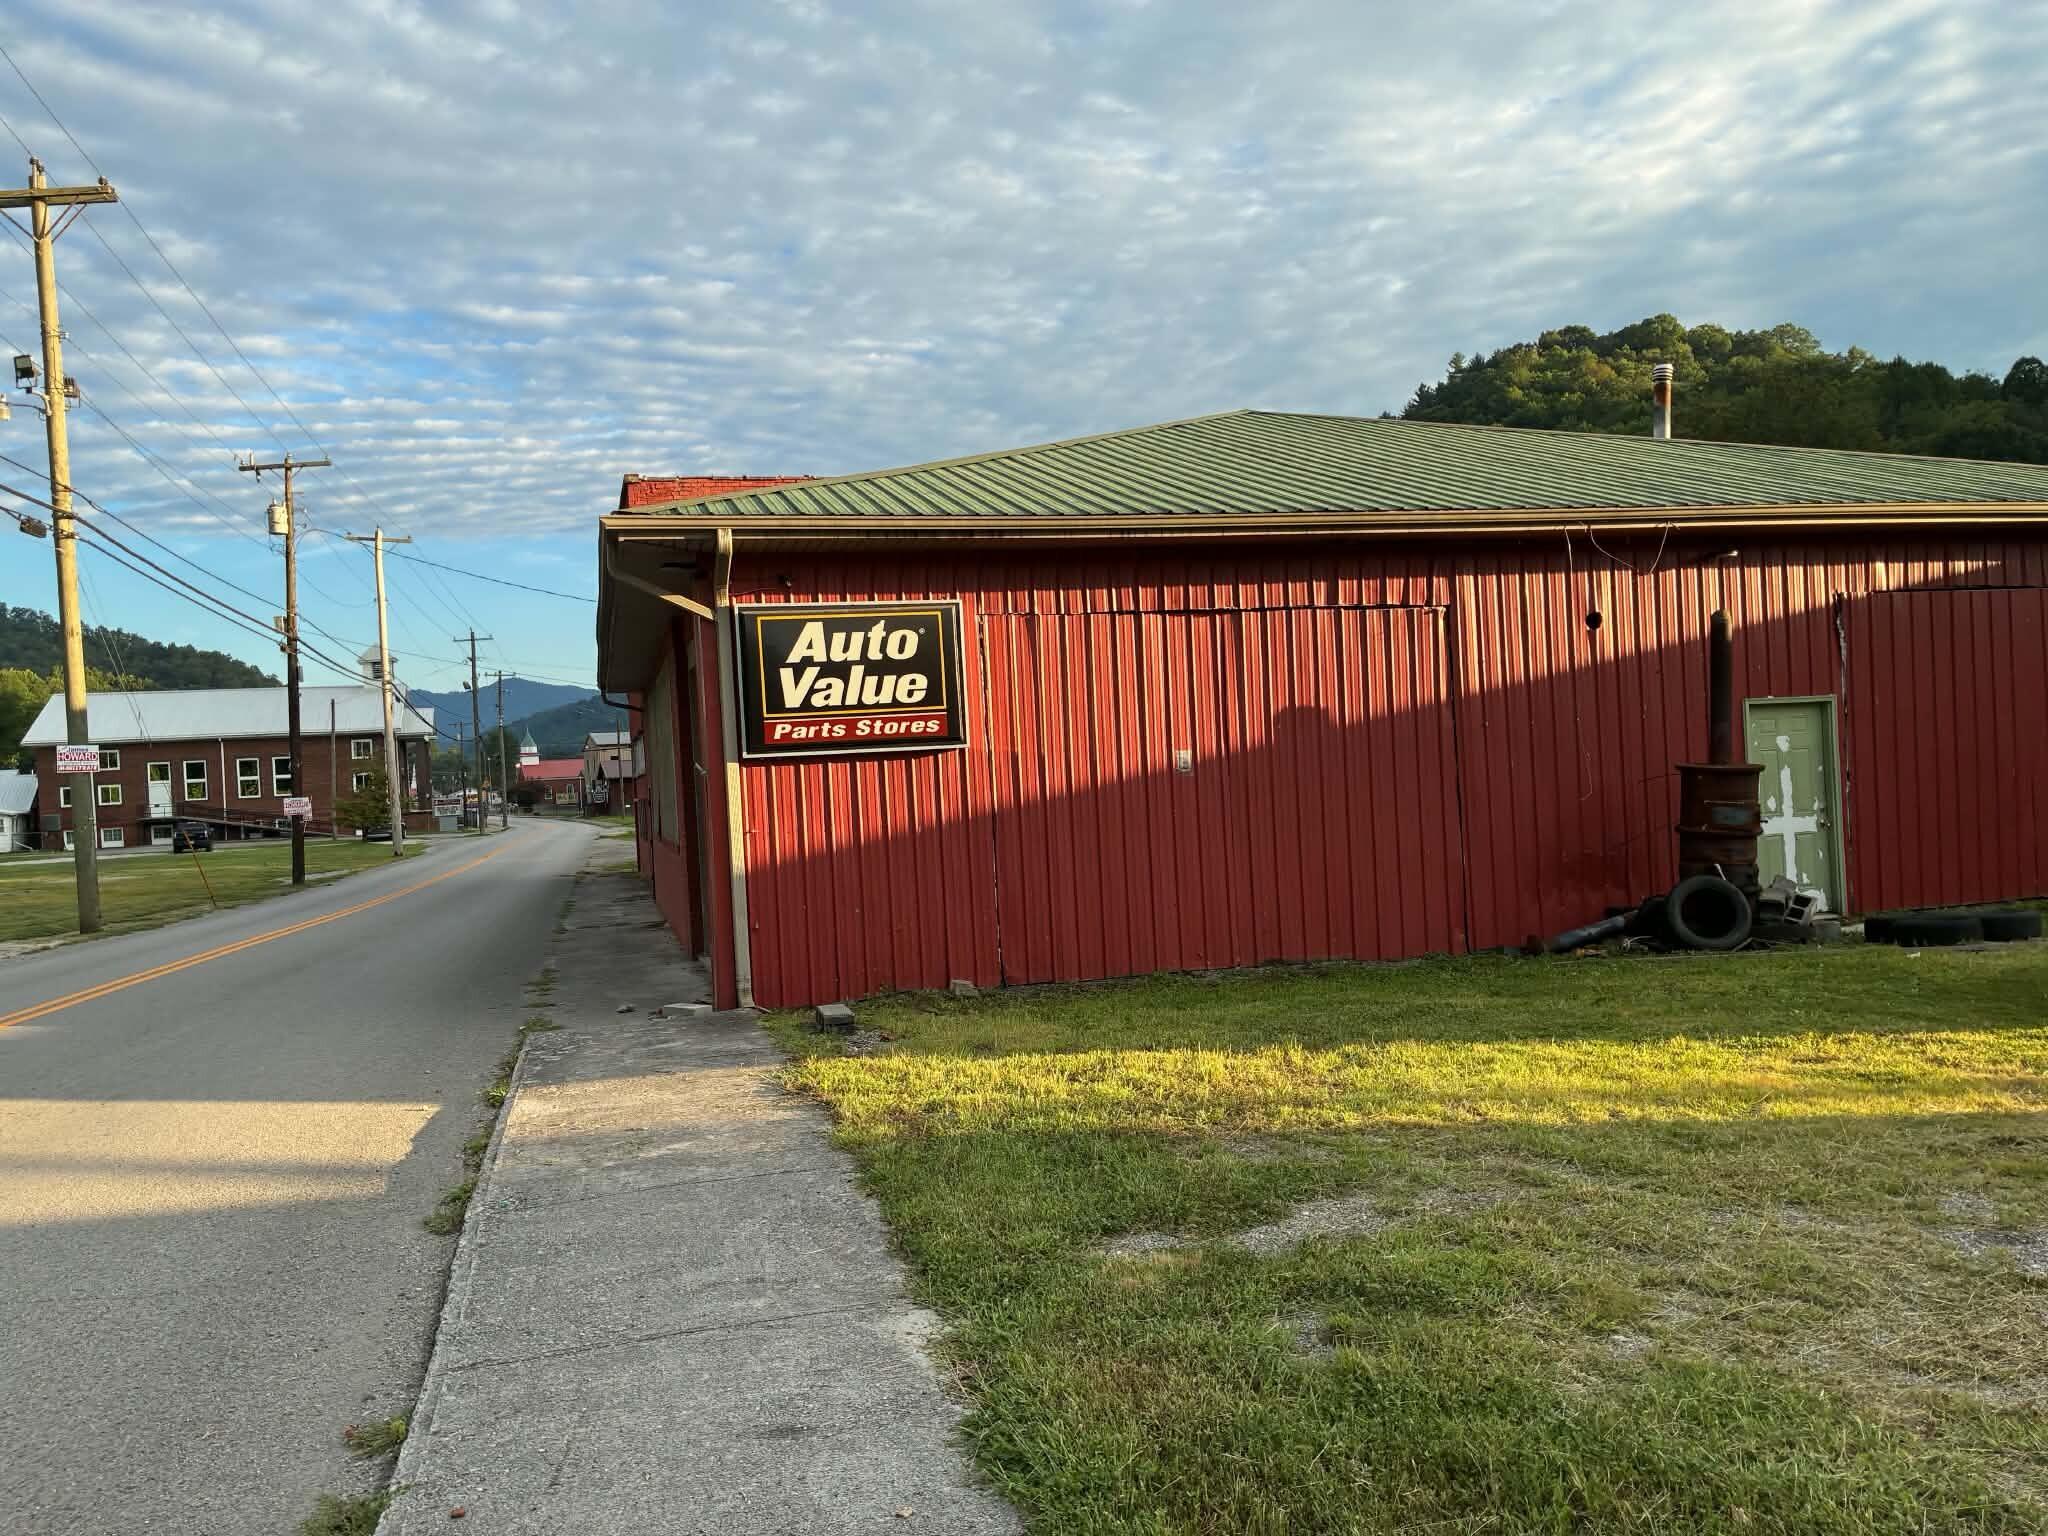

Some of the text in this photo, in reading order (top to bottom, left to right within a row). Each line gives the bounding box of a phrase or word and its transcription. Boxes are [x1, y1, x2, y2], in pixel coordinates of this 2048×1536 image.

[785, 619, 919, 664] Auto
[779, 664, 928, 709] Value
[773, 718, 941, 740] Parts Stores
[57, 752, 98, 761] HOWARD
